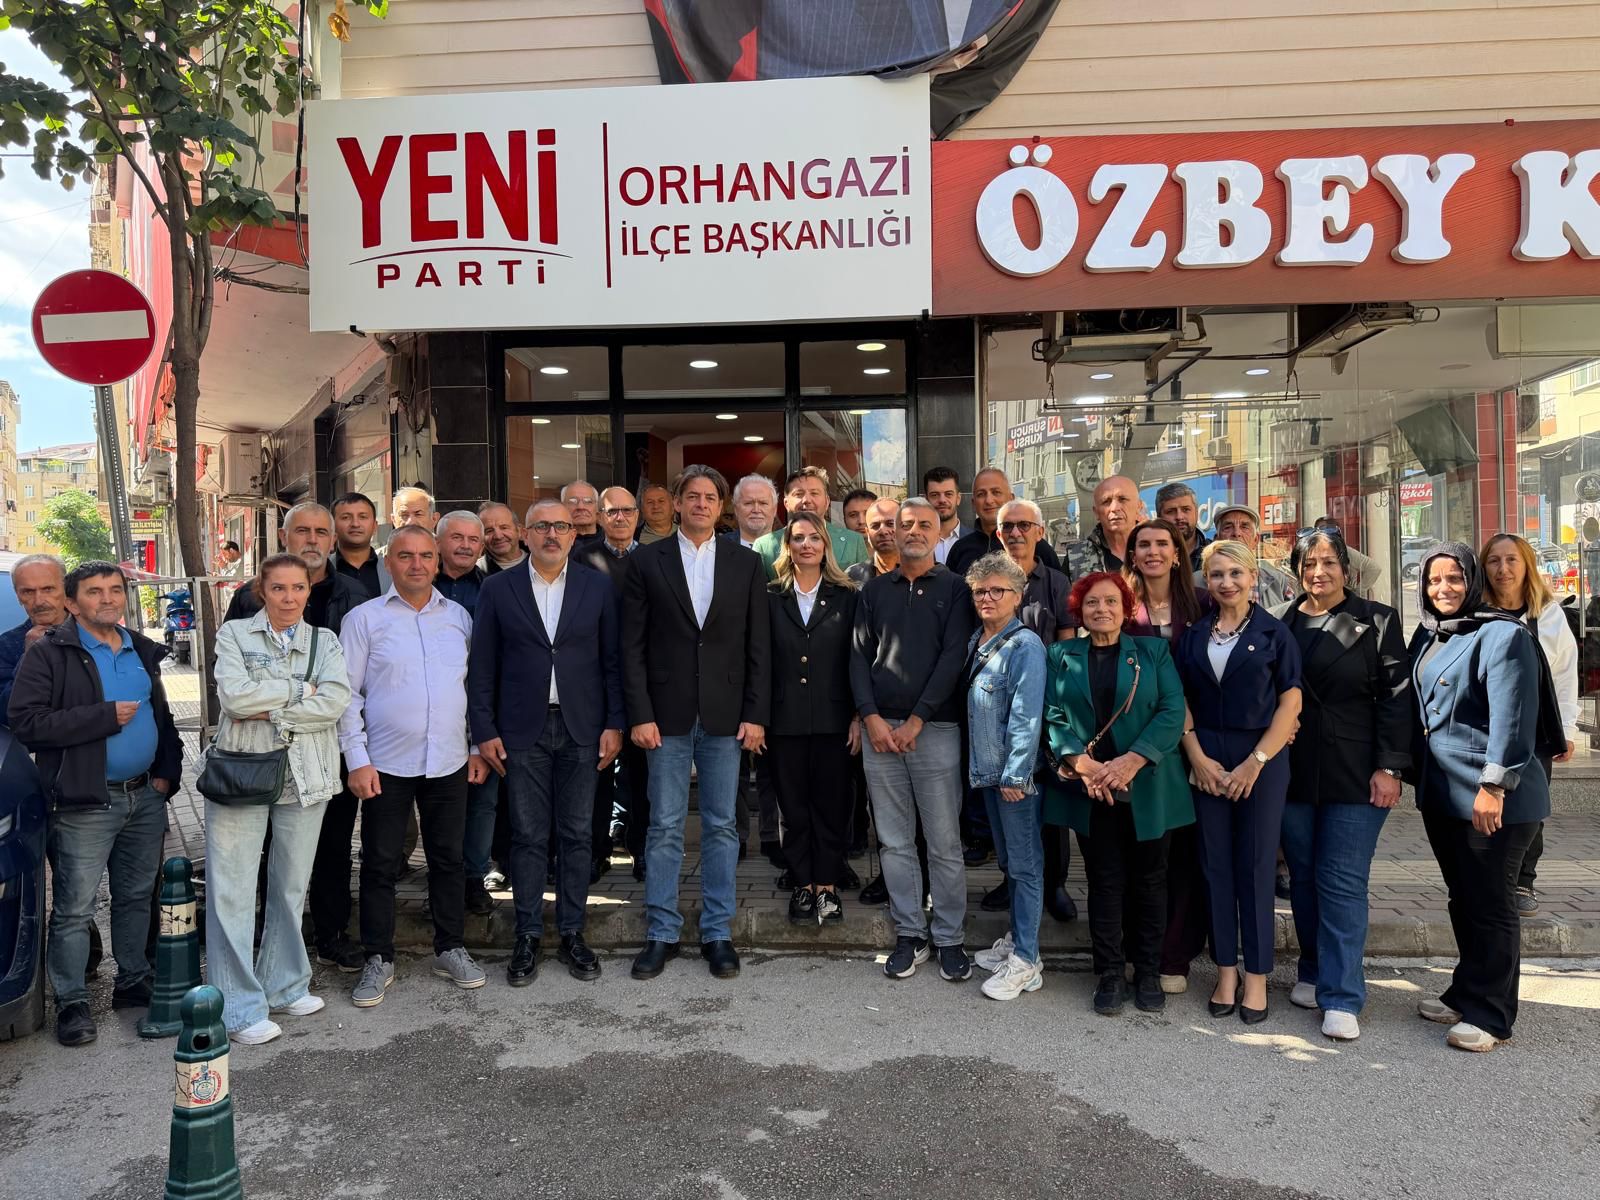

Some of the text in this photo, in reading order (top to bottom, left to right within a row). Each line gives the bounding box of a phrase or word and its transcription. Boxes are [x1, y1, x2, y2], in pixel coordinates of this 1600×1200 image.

[336, 129, 558, 248] YENİ
[619, 146, 910, 206] ORHANGAZİ
[621, 209, 911, 262] İLÇE BAŞKANLIĞI
[975, 143, 1476, 277] ÖZBEY
[377, 259, 545, 289] PARTİ
